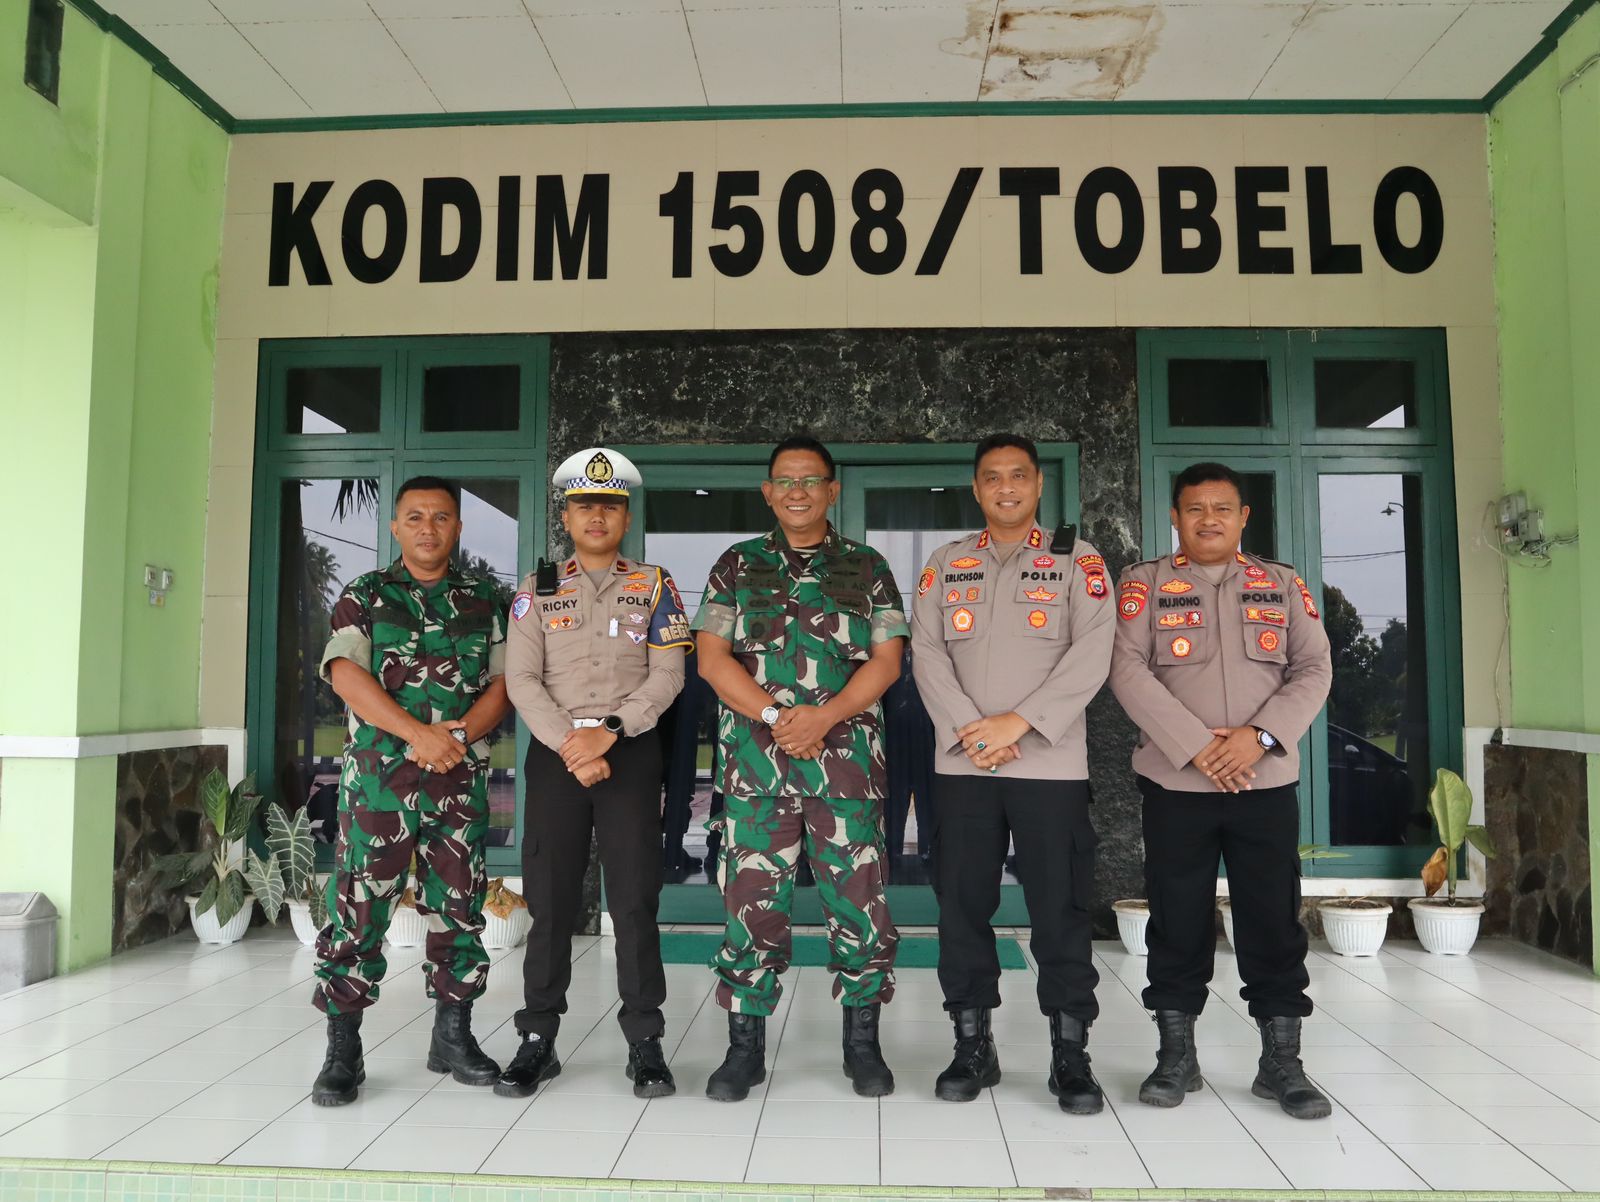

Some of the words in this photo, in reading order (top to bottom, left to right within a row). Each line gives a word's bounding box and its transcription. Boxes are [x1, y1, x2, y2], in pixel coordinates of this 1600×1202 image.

[269, 174, 610, 287] KODIM
[659, 165, 1445, 279] 1508/TOBELO
[945, 571, 985, 583] ERLICHSON
[1020, 571, 1063, 581] POLRI
[617, 596, 651, 608] POLR
[1158, 596, 1200, 608] RUJIONO
[1241, 593, 1283, 604] POLRI
[542, 599, 578, 612] RICKY
[667, 614, 688, 625] KA
